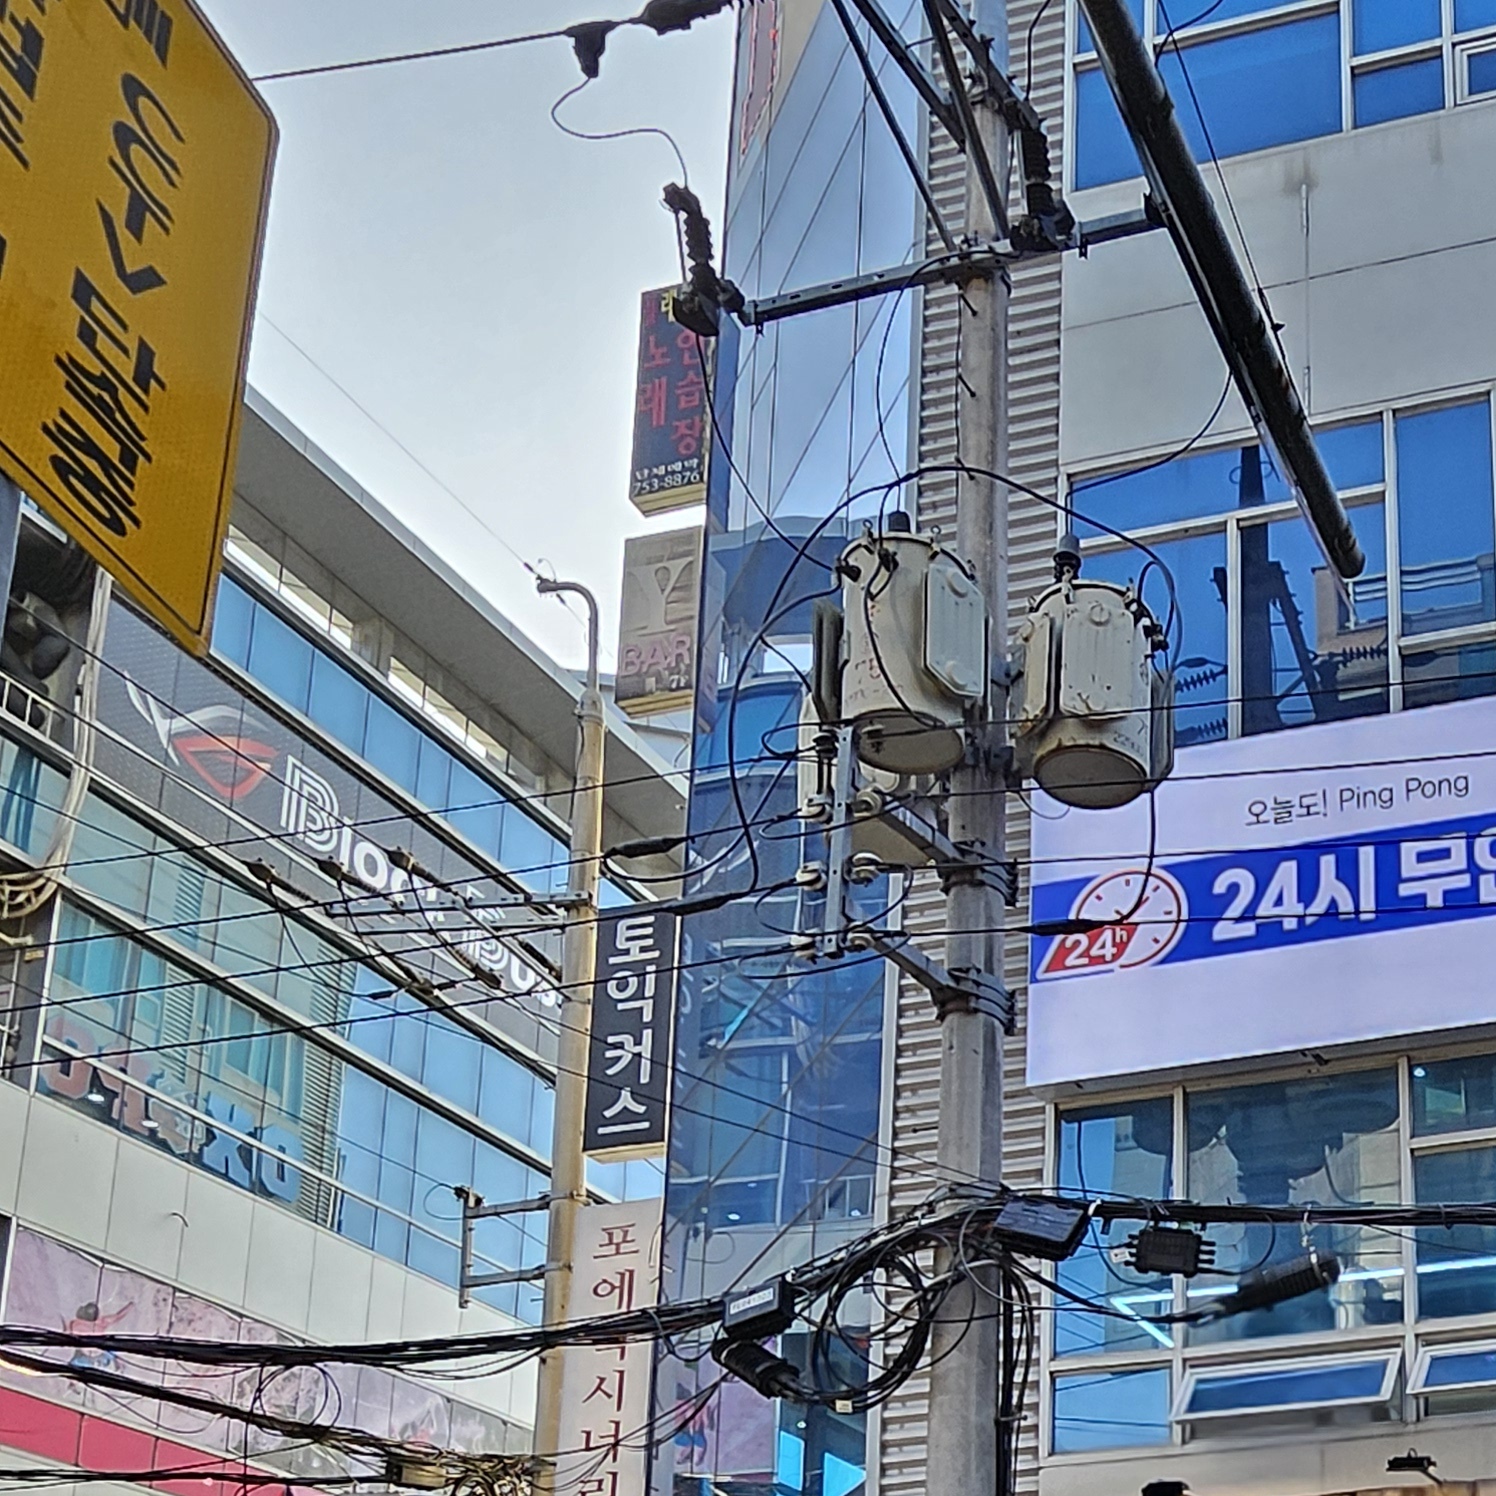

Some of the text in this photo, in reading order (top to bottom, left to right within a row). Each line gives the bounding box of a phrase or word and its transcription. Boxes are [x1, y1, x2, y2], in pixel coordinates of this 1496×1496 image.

[619, 634, 691, 678] BAR
[1246, 771, 1470, 827] 오늘도! Ping Pong
[1210, 844, 1378, 942] 24시
[596, 915, 661, 1135] 토익커스
